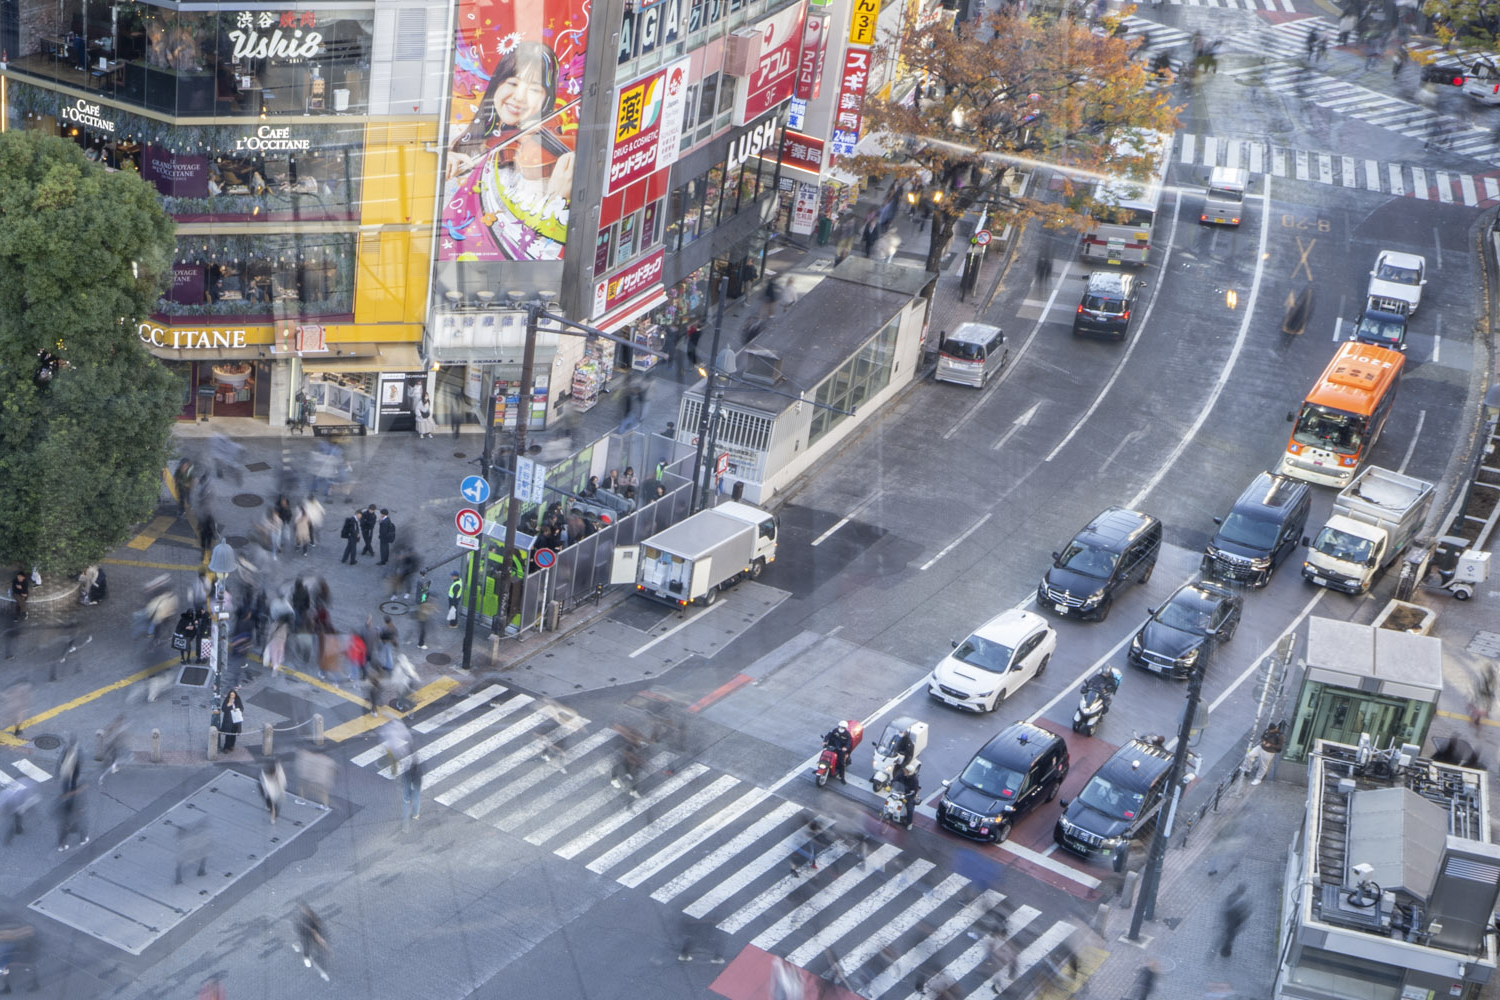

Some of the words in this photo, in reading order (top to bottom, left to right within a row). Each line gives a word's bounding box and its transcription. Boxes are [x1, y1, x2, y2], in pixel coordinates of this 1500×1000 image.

[857, 16, 869, 40] 3F
[229, 29, 322, 59] Ushi8
[757, 47, 790, 88] アコム
[800, 50, 815, 84] アコム
[765, 87, 777, 107] 3F
[838, 53, 867, 129] スギ薬局
[62, 106, 115, 132] L'OCCITANE
[77, 98, 100, 117] CAFÉ
[619, 90, 642, 138] 薬
[236, 136, 310, 150] L'OCCITANE
[258, 125, 290, 139] CAFÉ
[613, 144, 629, 159] DRUG
[633, 129, 659, 150] COSMETIC
[727, 116, 777, 171] LUSH
[610, 144, 657, 183] サンドラッグ
[832, 143, 853, 155] 営業
[152, 159, 173, 170] GRAND
[173, 163, 200, 171] VOYAGE
[624, 256, 663, 289] サンドラッグ
